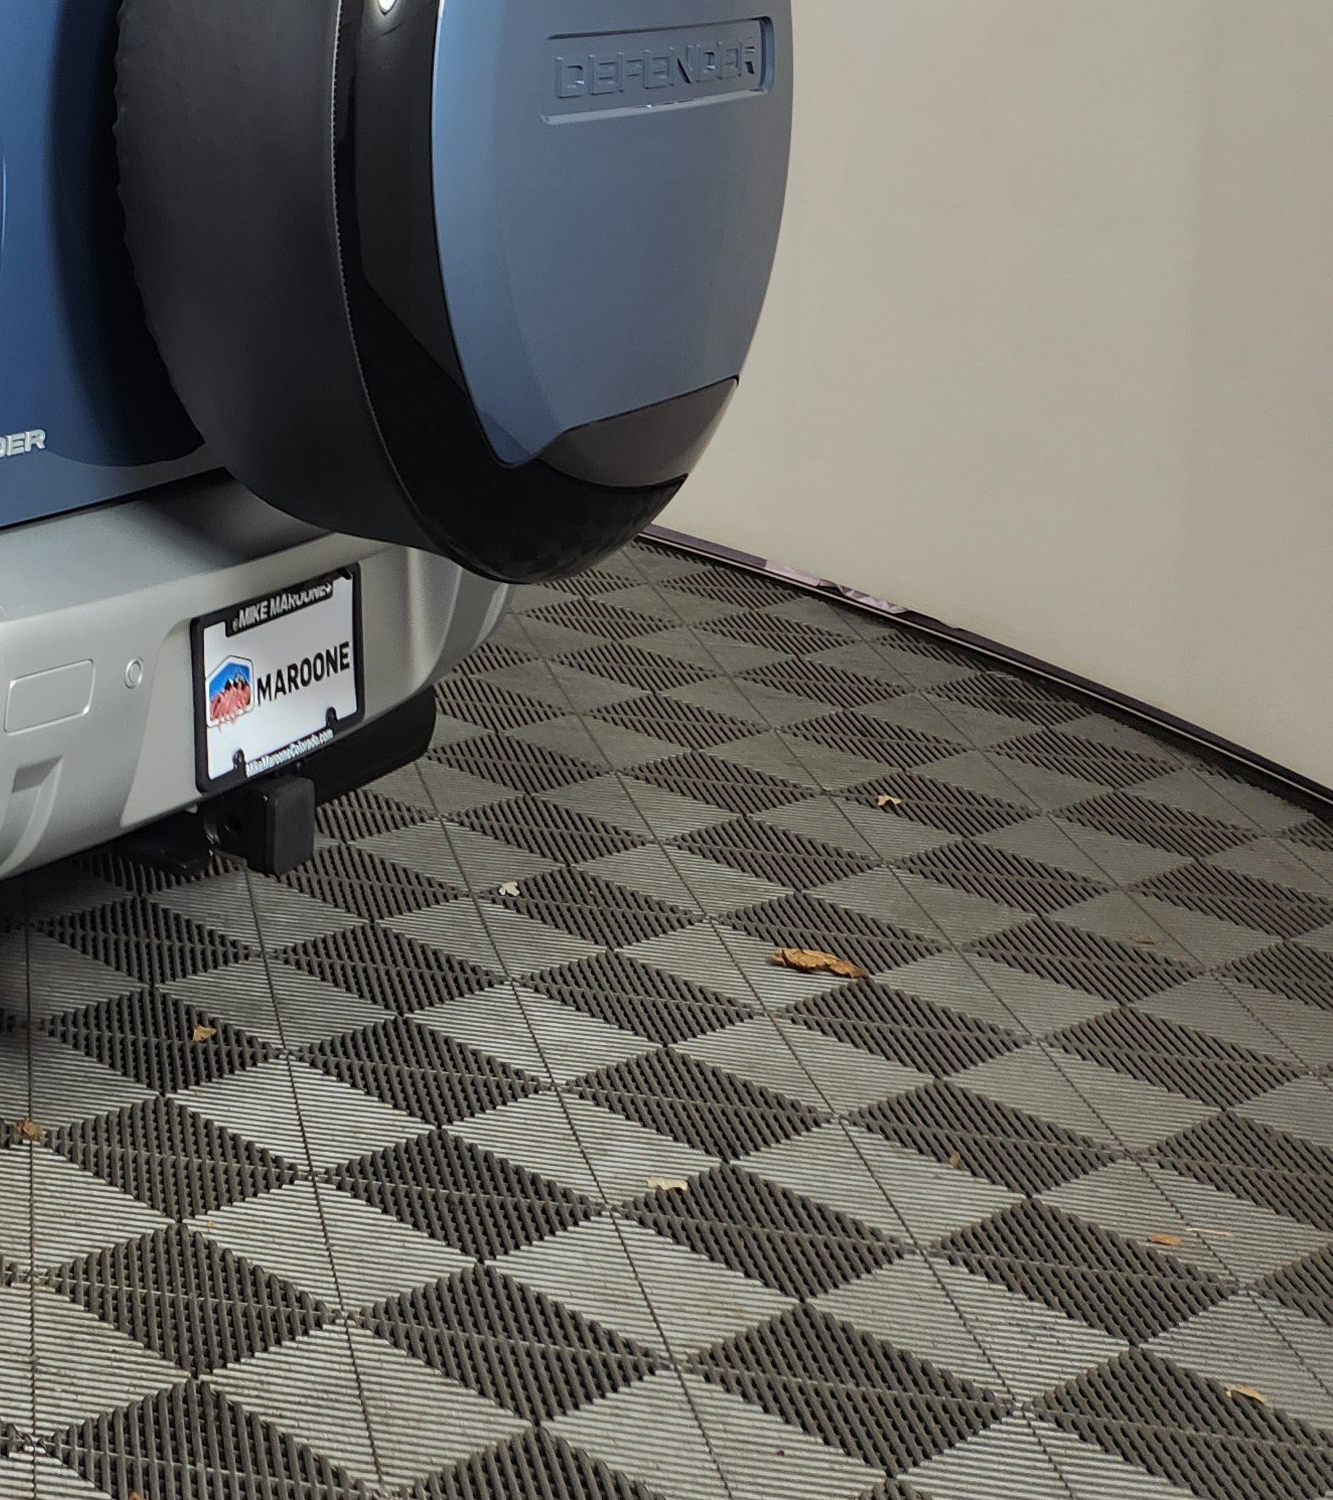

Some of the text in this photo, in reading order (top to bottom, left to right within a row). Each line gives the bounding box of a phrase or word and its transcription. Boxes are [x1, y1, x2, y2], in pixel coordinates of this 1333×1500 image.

[554, 37, 756, 99] DEFENDER
[238, 601, 268, 629] MIKE
[257, 641, 350, 706] MAROONE
